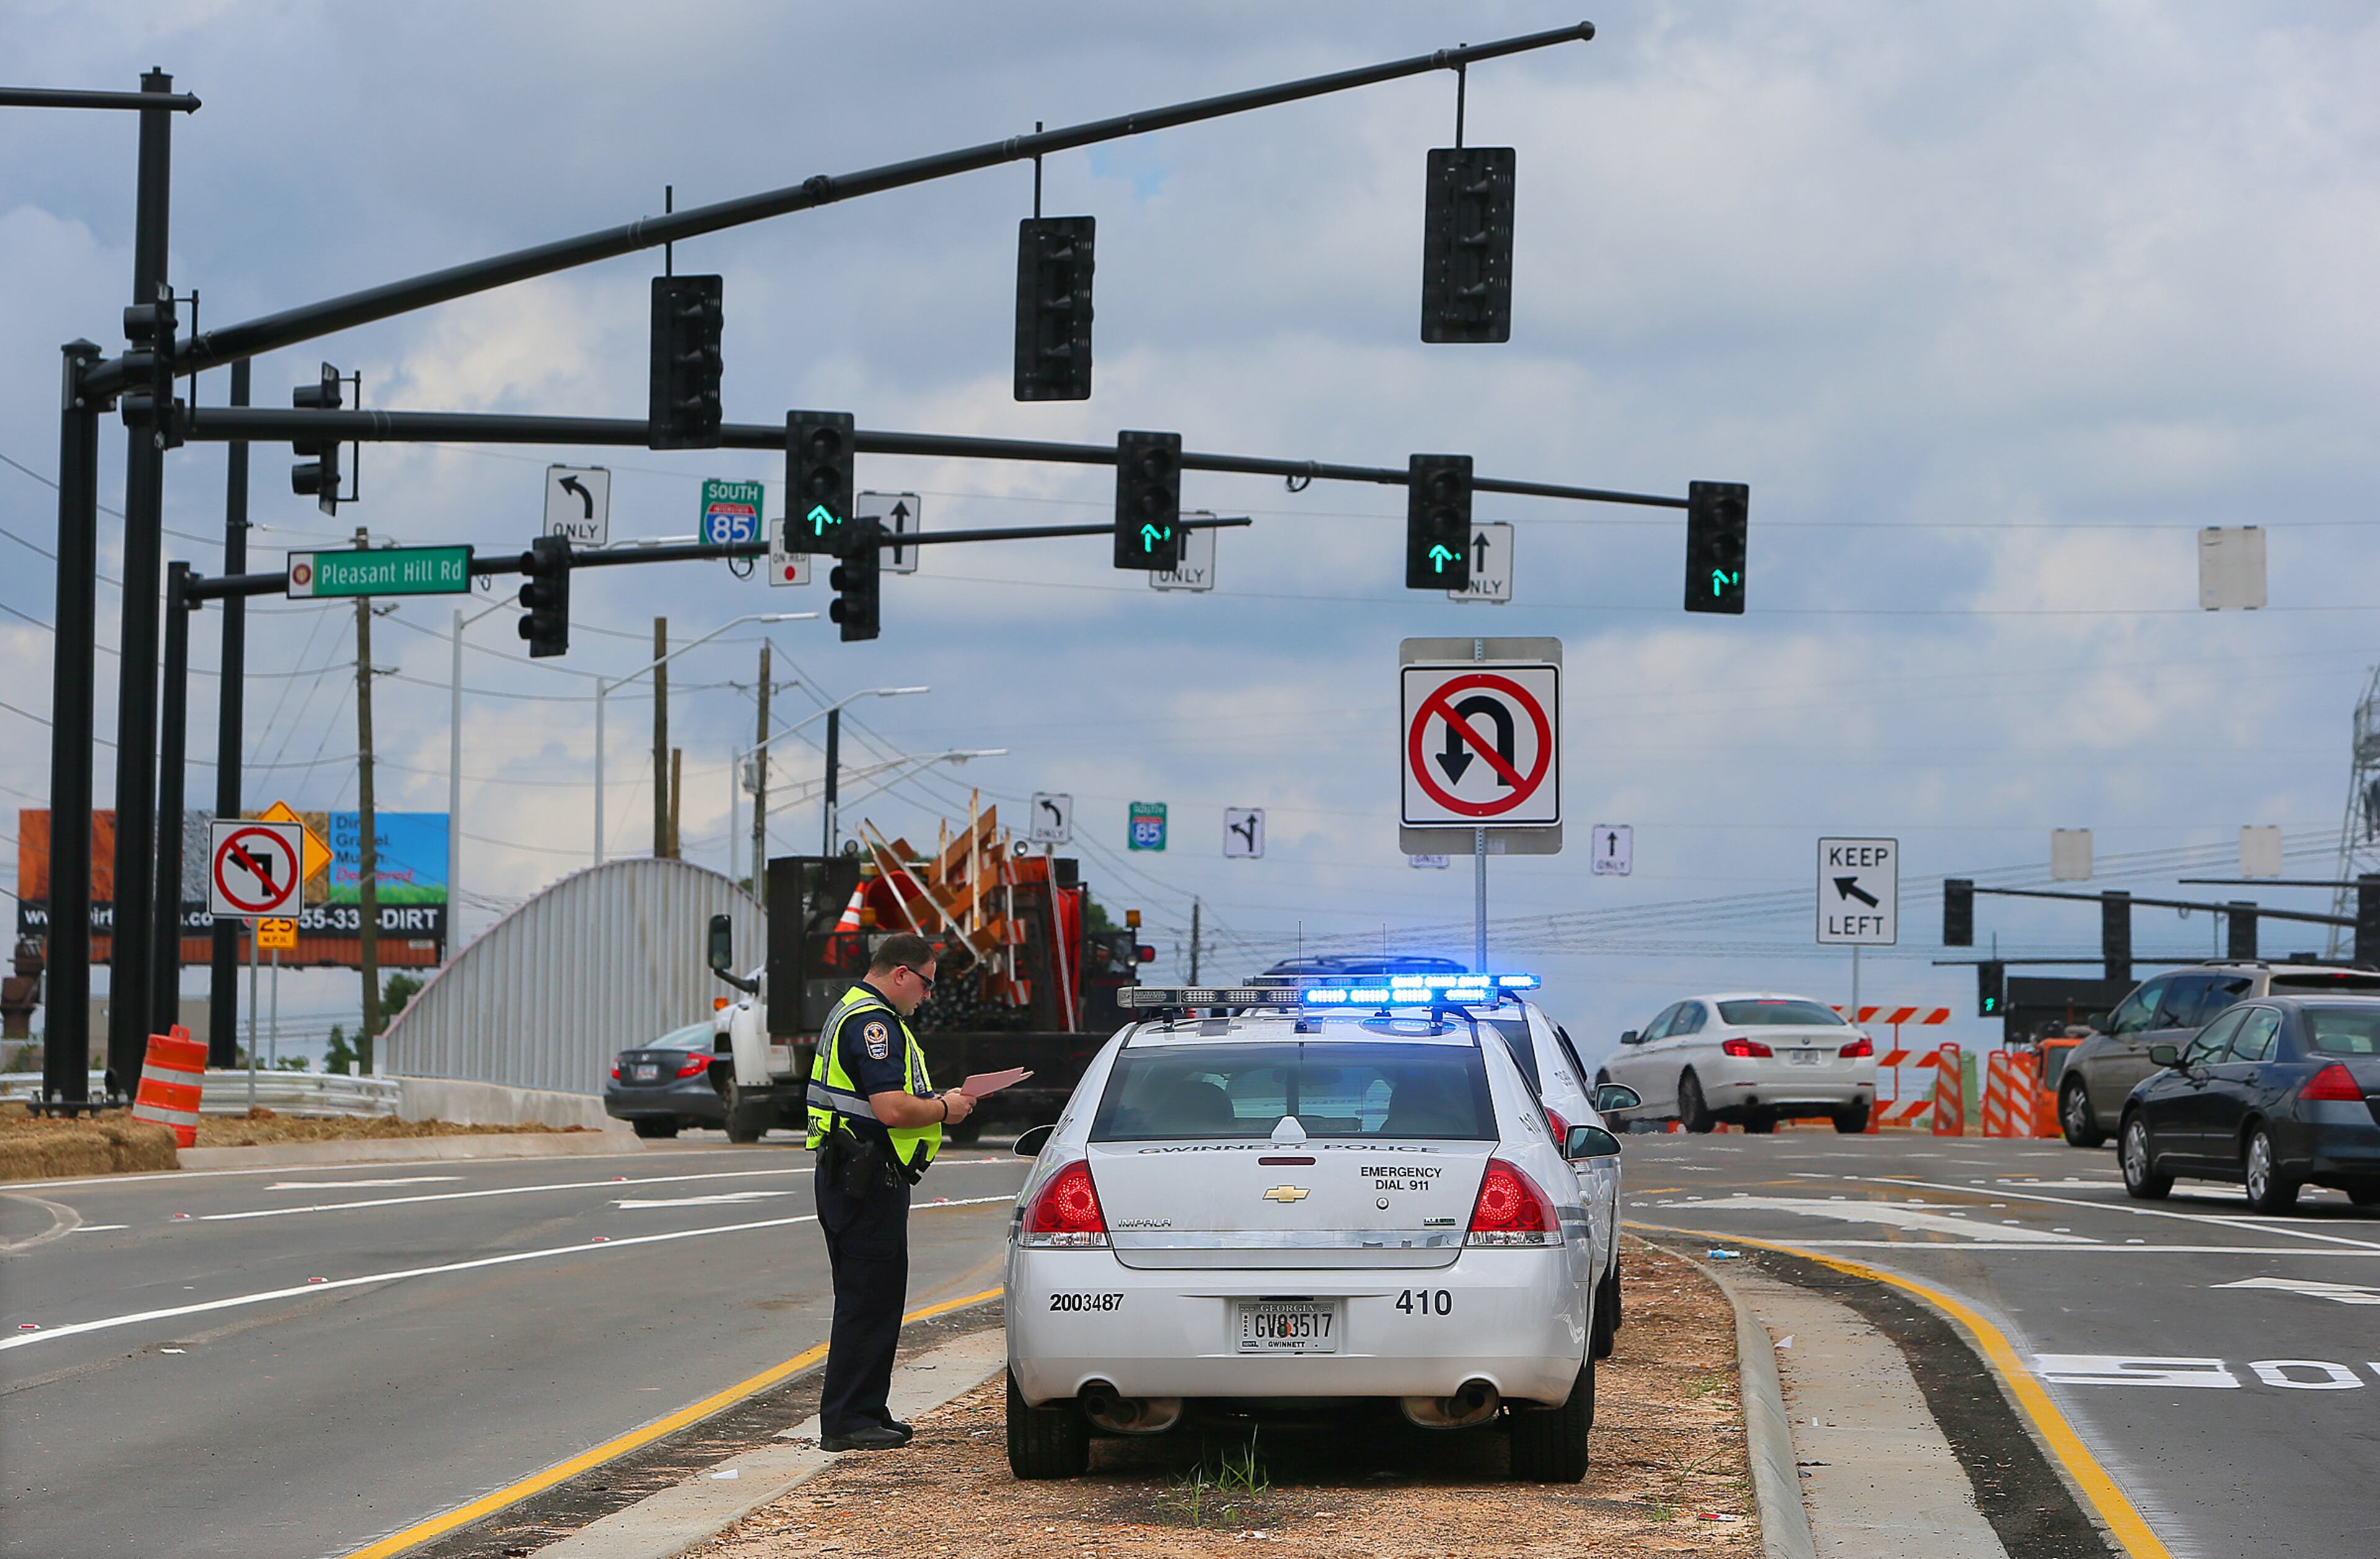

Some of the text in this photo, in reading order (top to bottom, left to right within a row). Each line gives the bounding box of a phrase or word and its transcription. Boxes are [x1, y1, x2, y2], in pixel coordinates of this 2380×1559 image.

[708, 484, 757, 500] SOUTH
[553, 523, 598, 537] ONLY
[712, 515, 751, 544] 85
[322, 559, 462, 585] Pleasant Hill Rd
[1159, 568, 1205, 583] ONLY
[1459, 580, 1502, 593] NLY
[336, 816, 359, 829] Dir
[336, 833, 391, 847] Grel.
[1135, 823, 1161, 842] 85
[1830, 847, 1888, 866] KEEP
[260, 919, 293, 932] 25
[1830, 916, 1884, 935] LEFT
[1518, 1112, 1541, 1135] 410
[1138, 1144, 1440, 1154] GWINNETT POLICE
[1361, 1167, 1442, 1178] EMERGENCY
[1375, 1180, 1429, 1190] DIAL 911
[1118, 1218, 1171, 1227] IMPALA
[1050, 1294, 1124, 1311] 2003487
[1260, 1304, 1315, 1312] GEORGIA
[1396, 1290, 1452, 1315] 410
[1255, 1314, 1332, 1337] GV83517
[2034, 1354, 2380, 1390] SO
